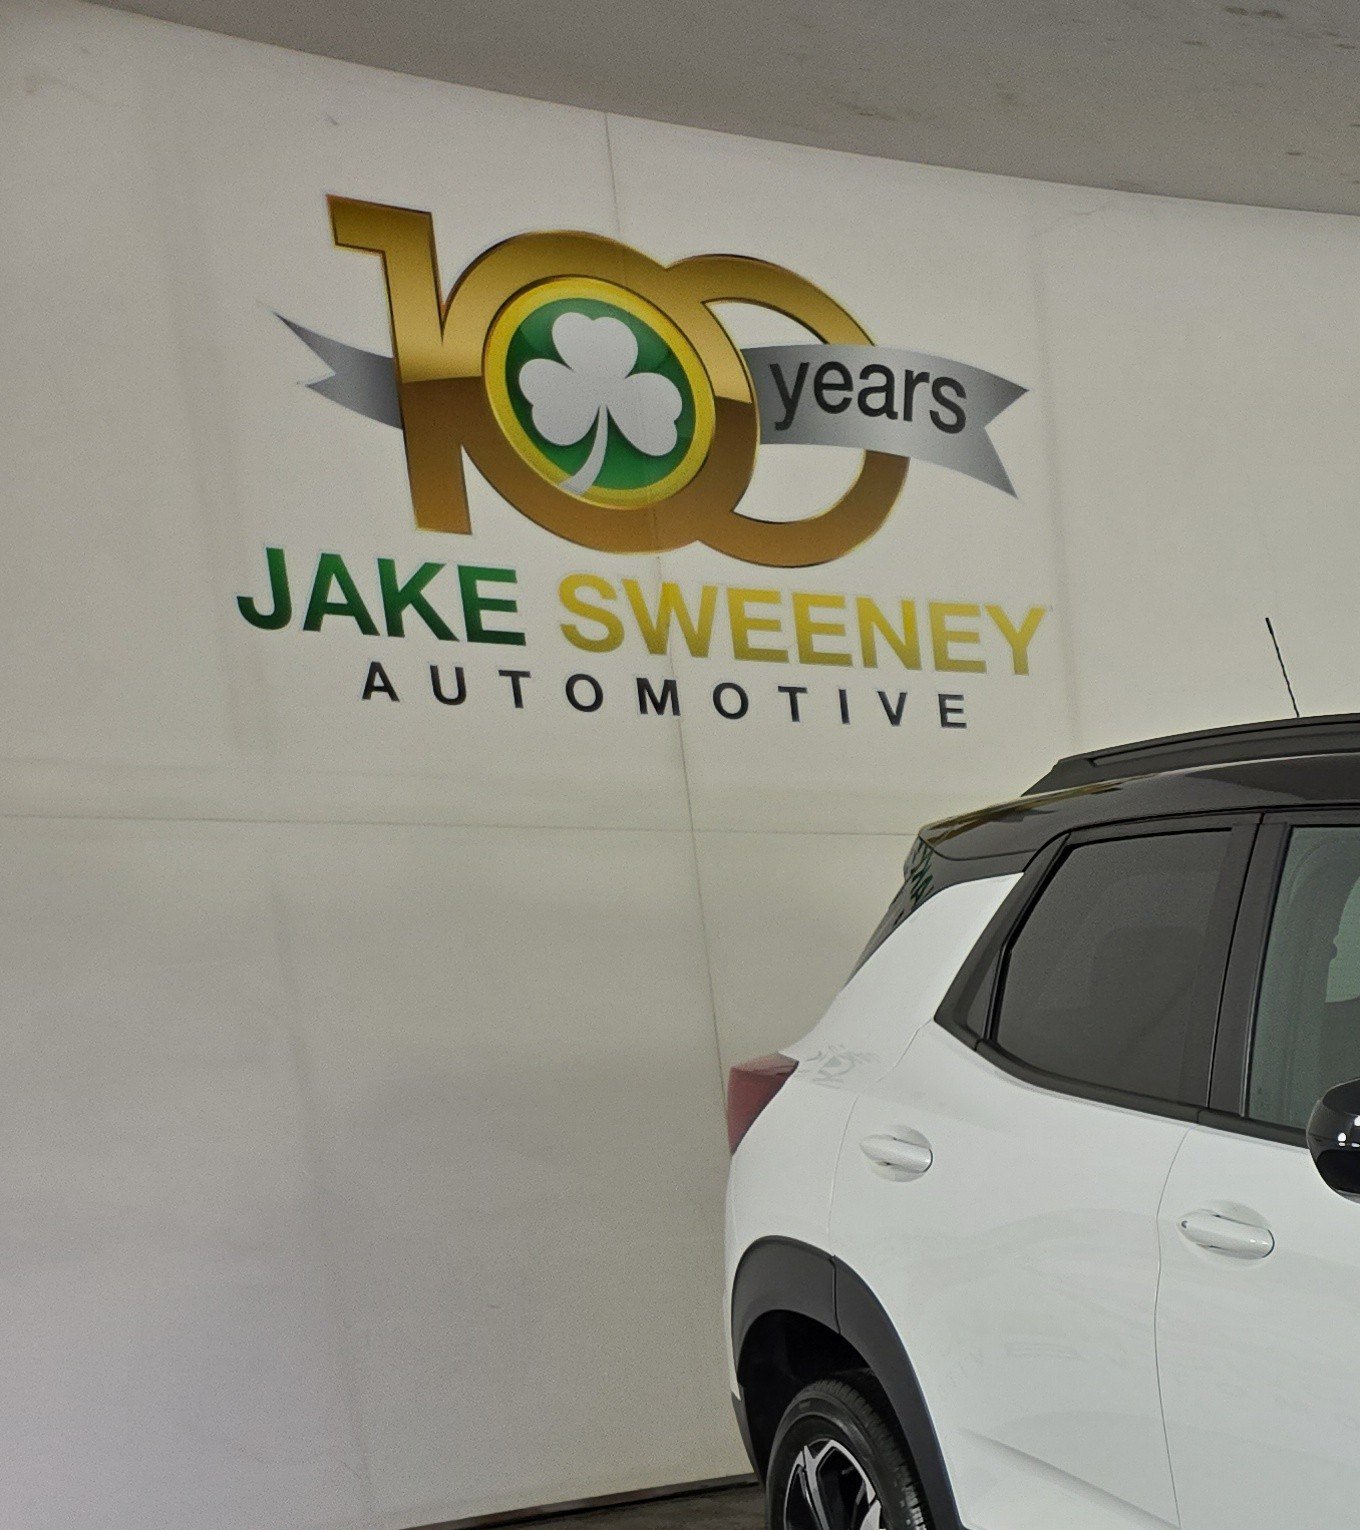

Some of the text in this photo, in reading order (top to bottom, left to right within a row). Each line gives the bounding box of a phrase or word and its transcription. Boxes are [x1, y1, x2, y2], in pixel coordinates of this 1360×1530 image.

[326, 195, 911, 568] 100
[768, 358, 968, 435] years
[235, 546, 1048, 677] JAKE SWEENEY
[361, 660, 969, 730] AUTOMOTIVE
